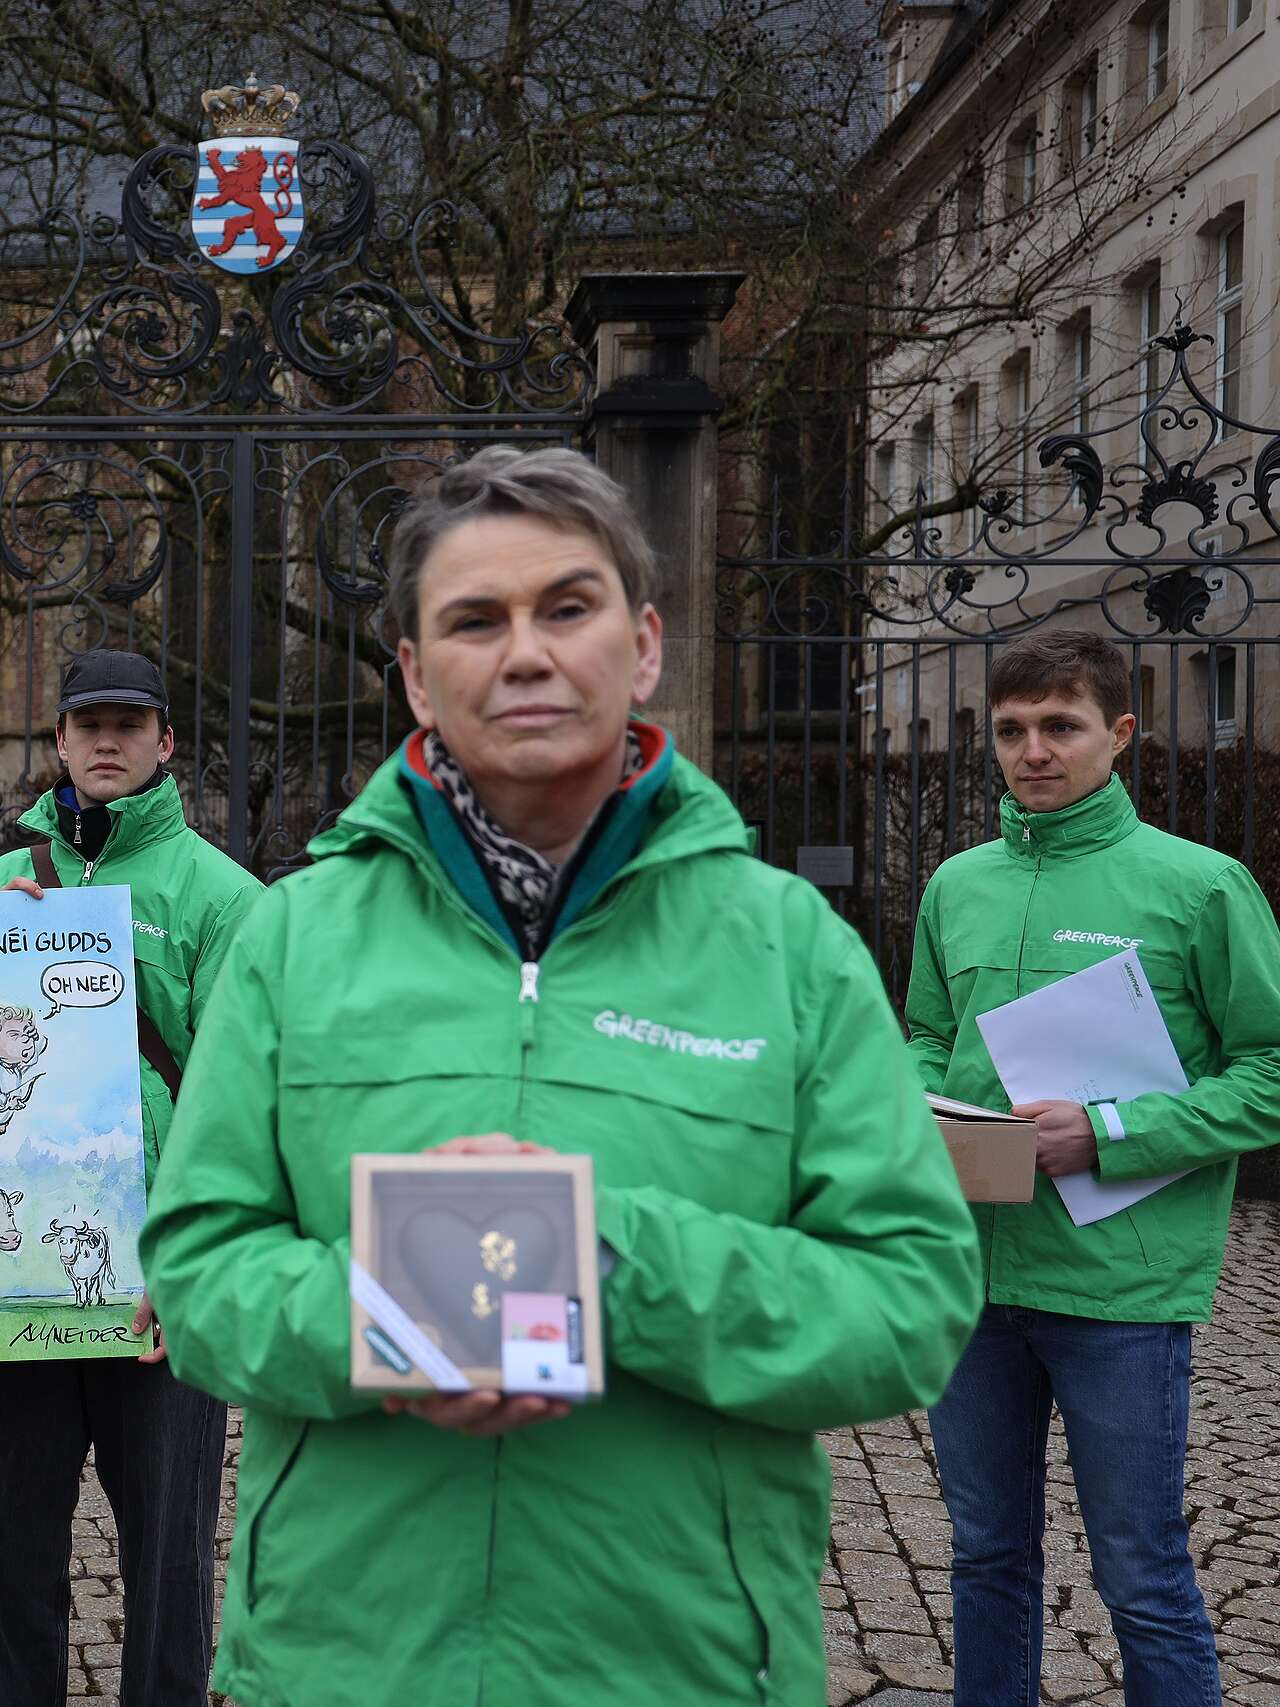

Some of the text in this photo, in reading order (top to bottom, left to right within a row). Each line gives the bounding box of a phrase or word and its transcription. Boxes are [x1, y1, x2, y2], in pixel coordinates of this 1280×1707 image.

[132, 919, 169, 939] PEACE
[1053, 929, 1144, 949] GREENPEACE
[35, 931, 112, 954] GUDDS
[48, 973, 118, 994] OH NEE!
[592, 1009, 768, 1061] GREENPEACE
